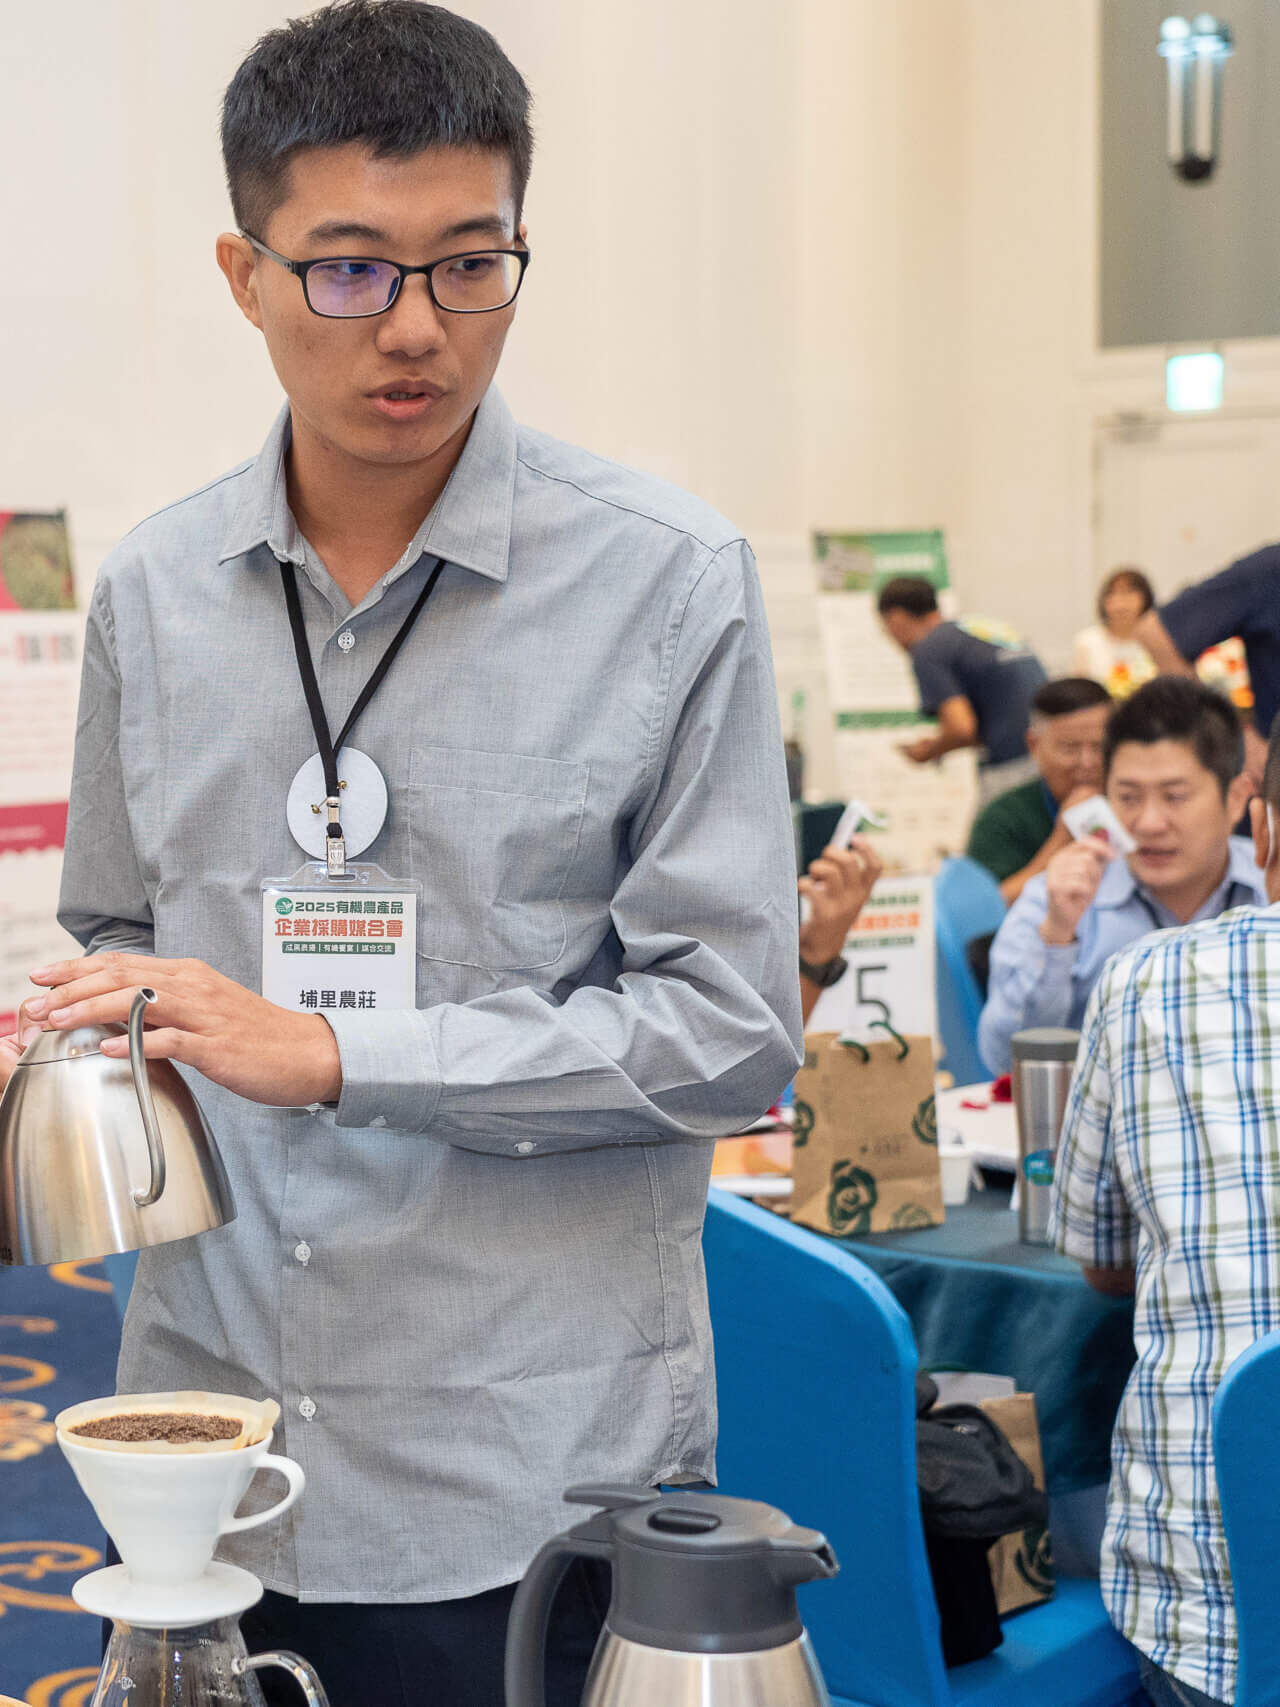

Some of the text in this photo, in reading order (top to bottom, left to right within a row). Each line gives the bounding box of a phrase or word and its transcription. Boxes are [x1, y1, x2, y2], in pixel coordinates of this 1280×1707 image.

[295, 901, 403, 914] 2025有機農產品
[275, 918, 403, 937] 企業採購媒合會
[299, 989, 376, 1008] 埔里農莊
